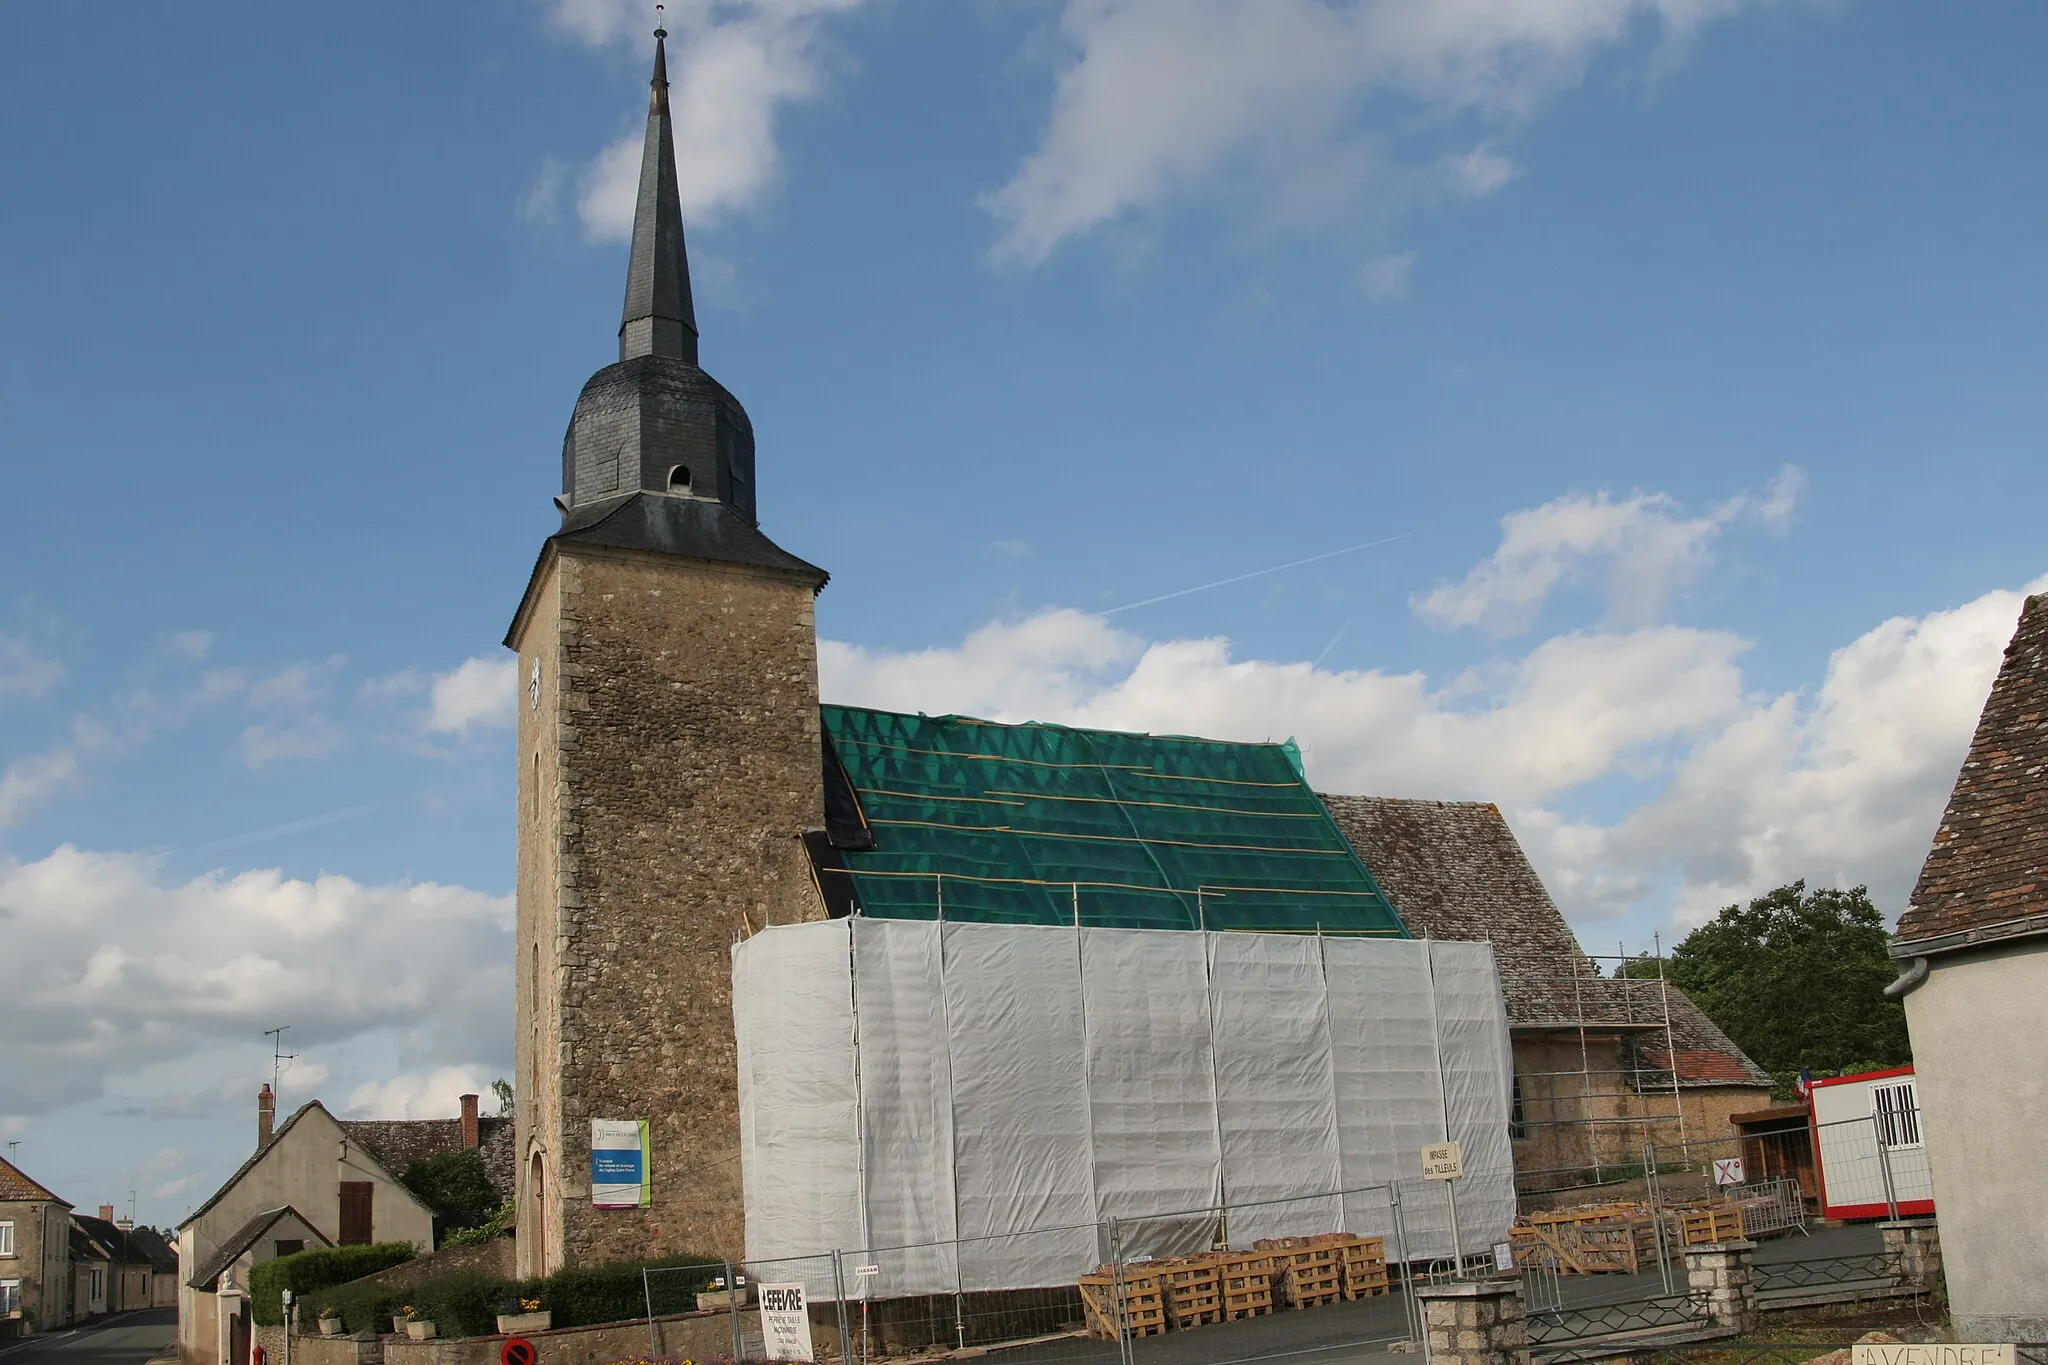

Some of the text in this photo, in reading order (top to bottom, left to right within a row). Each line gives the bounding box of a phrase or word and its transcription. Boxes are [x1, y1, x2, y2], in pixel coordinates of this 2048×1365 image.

[1429, 1149, 1448, 1160] IMPASSE
[1424, 1162, 1457, 1175] des TILLEULS
[762, 1288, 803, 1311] LEFEVRE
